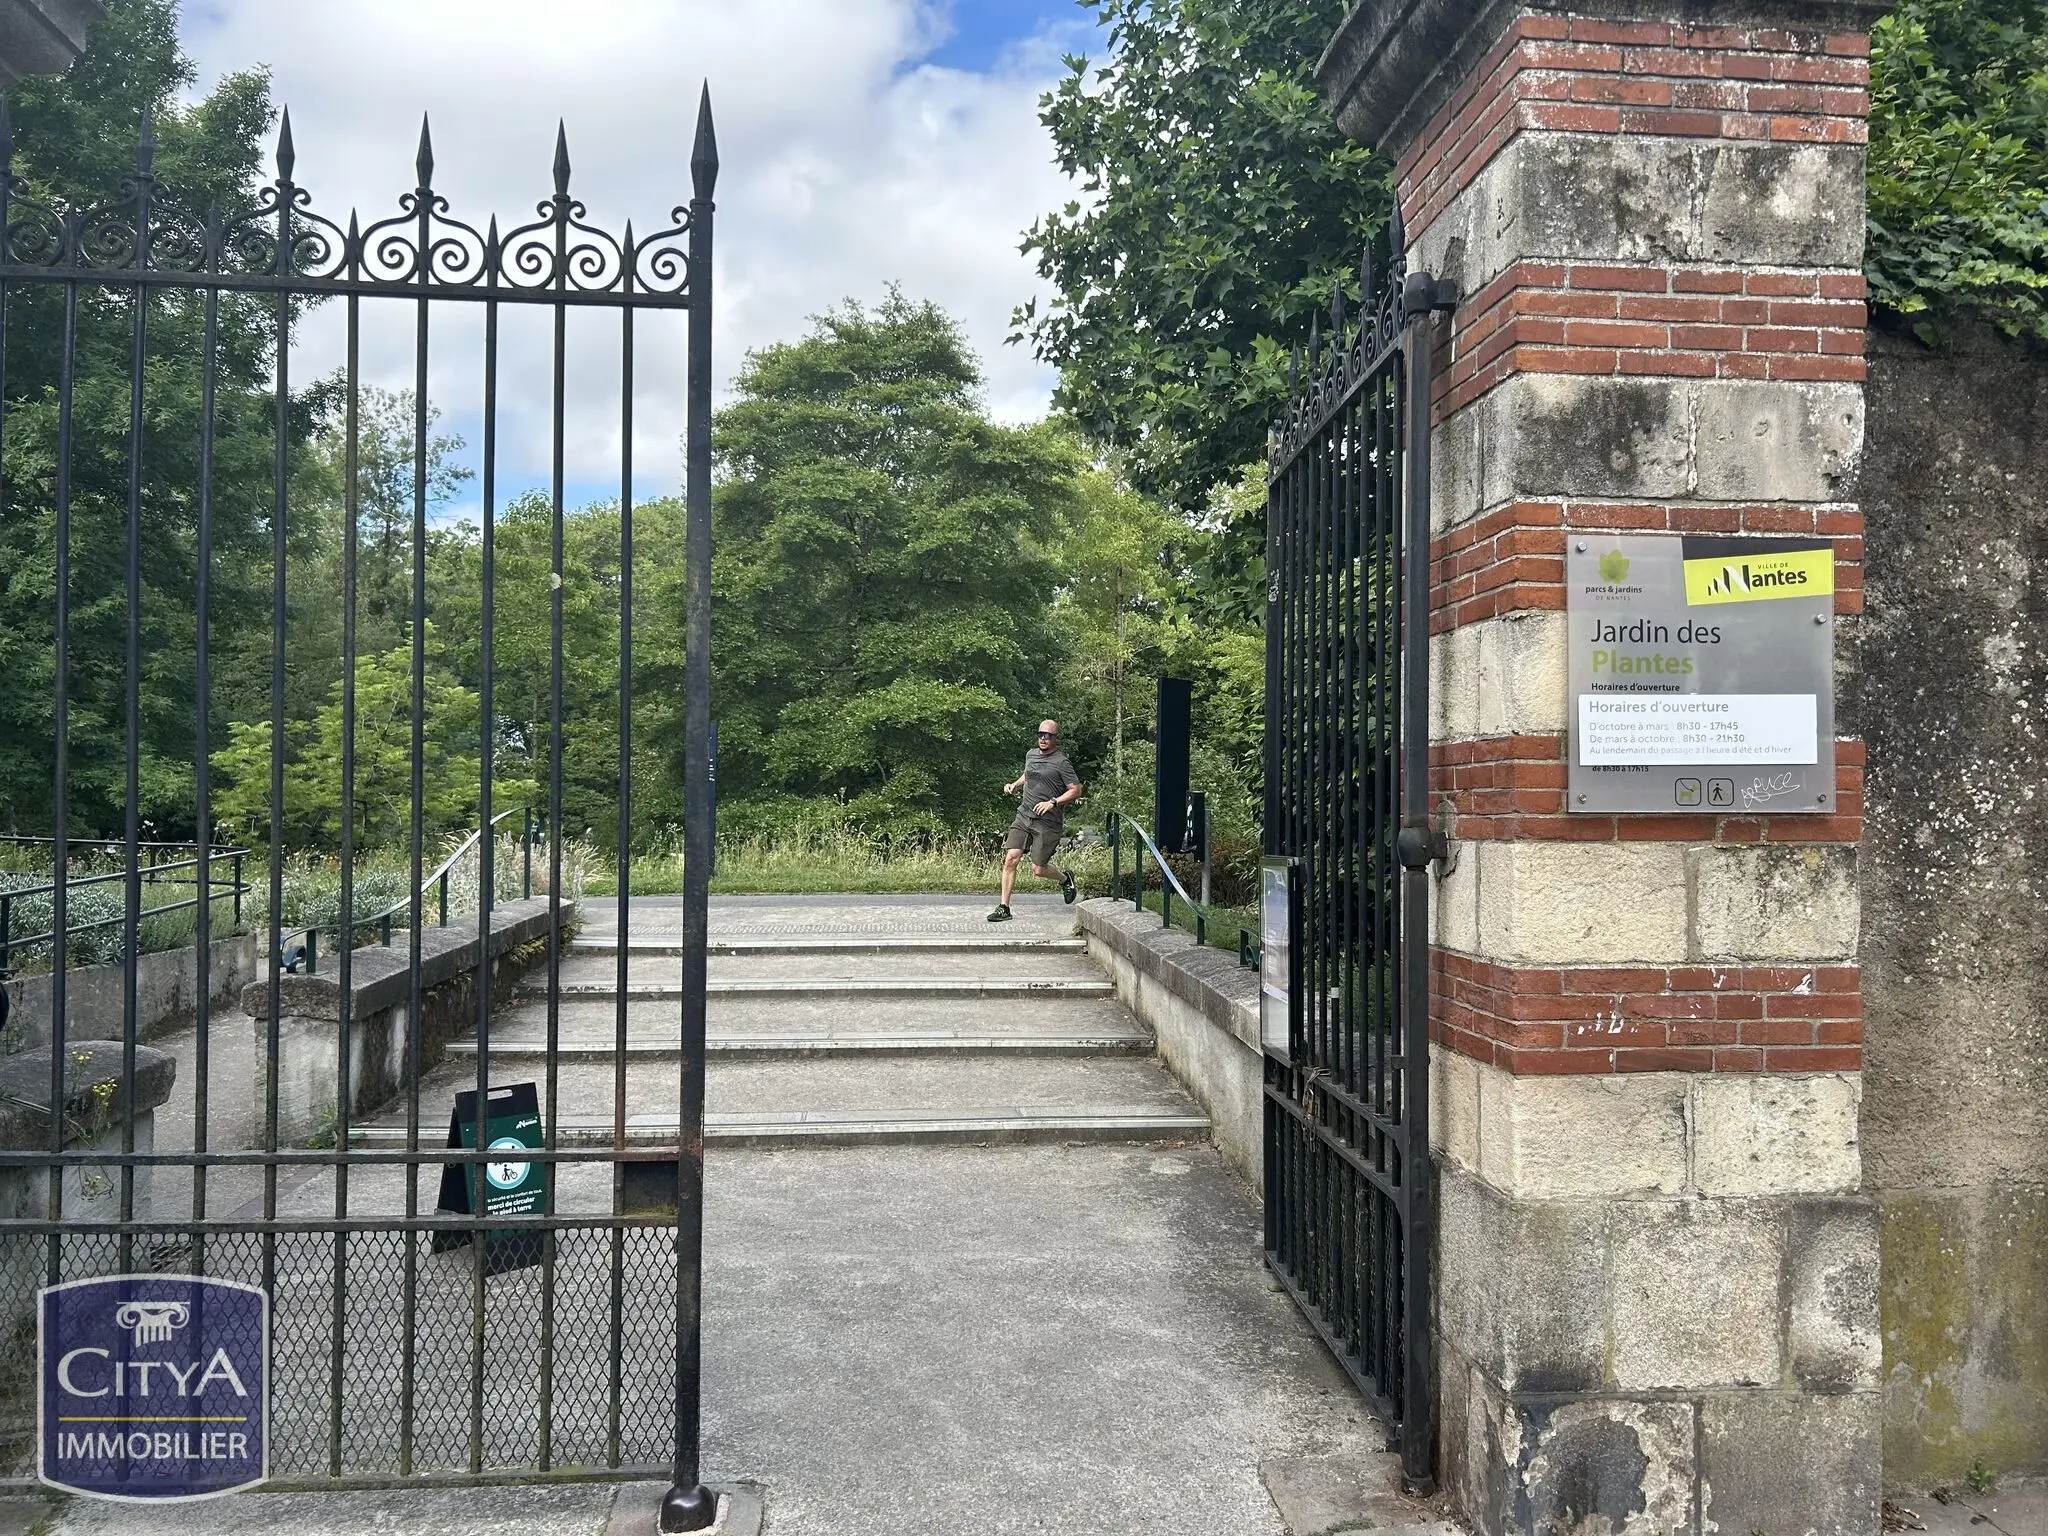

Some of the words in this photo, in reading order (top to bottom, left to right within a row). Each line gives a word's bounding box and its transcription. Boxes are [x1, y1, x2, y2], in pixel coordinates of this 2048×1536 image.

[1708, 564, 1808, 596] Nantes
[1585, 586, 1606, 594] parcs
[1615, 586, 1643, 594] jardins
[1591, 619, 1669, 644] Jardin
[1677, 619, 1721, 644] des
[1592, 649, 1694, 675] Plantes
[1591, 683, 1628, 692] Horaires
[1589, 701, 1647, 713] Horaires
[1676, 722, 1701, 731] 8h30
[1710, 721, 1739, 731] 17h45
[1590, 734, 1603, 743] De
[1638, 734, 1676, 743] octobre
[1682, 734, 1707, 743] 8h30
[1716, 734, 1745, 743] 21h30
[1590, 746, 1601, 754] Au
[1602, 746, 1647, 754] lendemain
[1649, 746, 1659, 754] du
[1660, 748, 1694, 756] passage
[1754, 746, 1762, 754] et
[488, 1202, 504, 1211] merci
[513, 1197, 535, 1206] circuler
